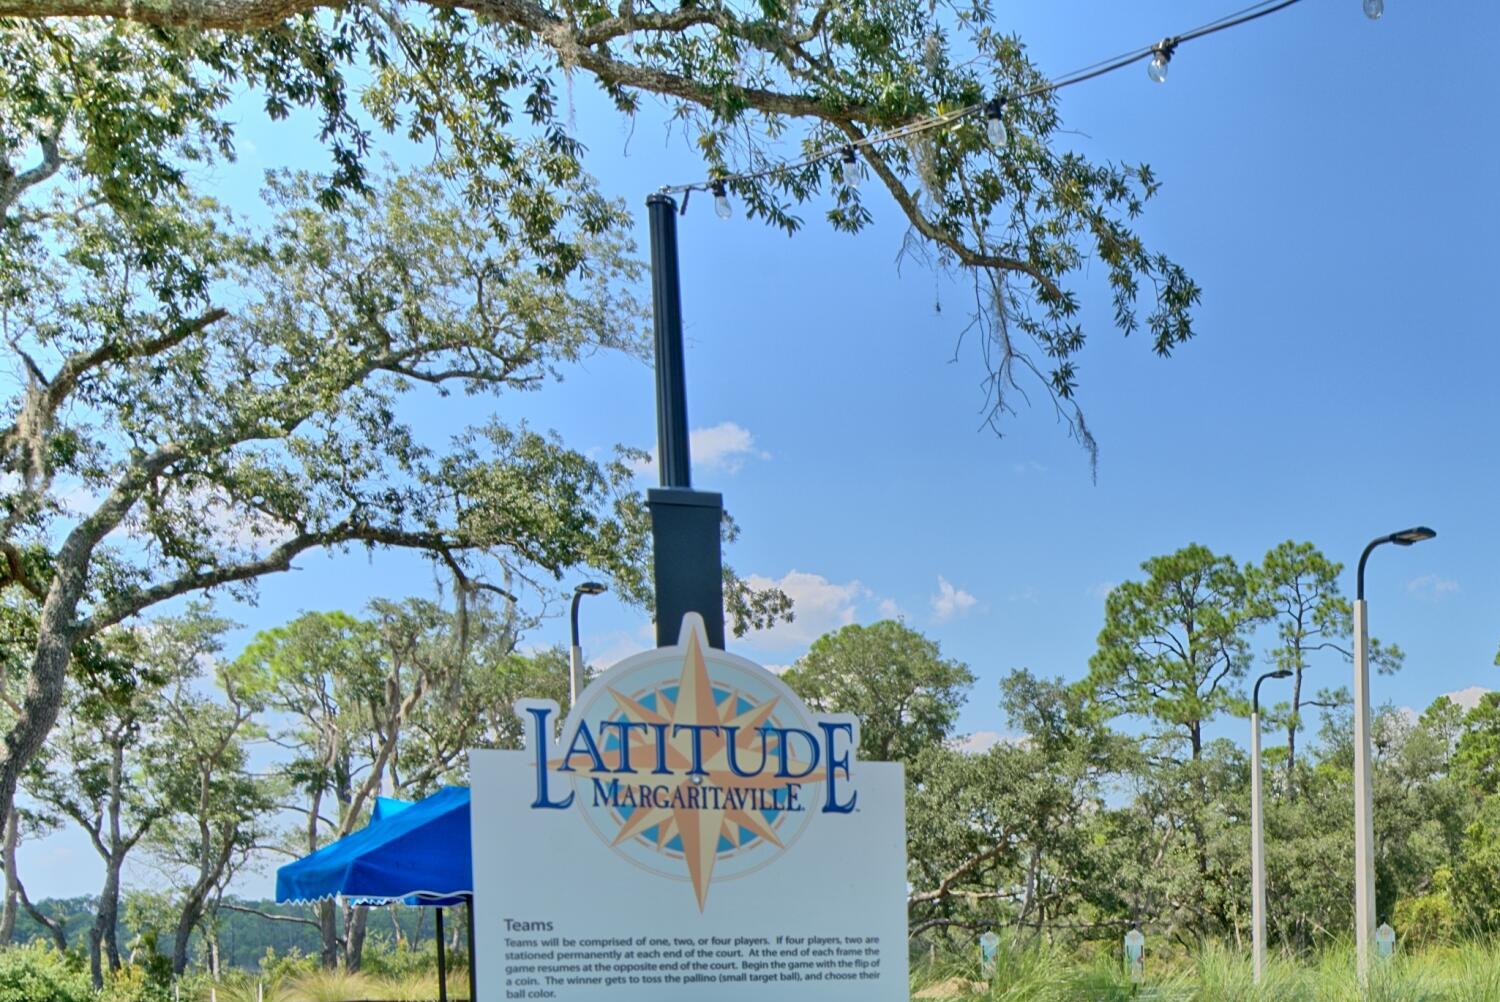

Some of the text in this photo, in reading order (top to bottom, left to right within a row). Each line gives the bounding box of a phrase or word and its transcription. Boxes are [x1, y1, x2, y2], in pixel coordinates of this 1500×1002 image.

[526, 707, 858, 815] LATITUDE
[505, 918, 554, 931] Teams
[503, 937, 538, 946] Teams
[540, 938, 558, 946] will
[562, 937, 576, 946] be
[578, 936, 633, 947] comprised
[634, 936, 647, 945] of
[648, 938, 671, 946] one,
[673, 937, 695, 946] two,
[710, 935, 732, 945] four
[733, 936, 770, 946] players.
[776, 935, 783, 944] If
[784, 935, 805, 944] four
[807, 935, 842, 946] players,
[844, 936, 863, 944] two
[505, 988, 556, 998] ball color.
